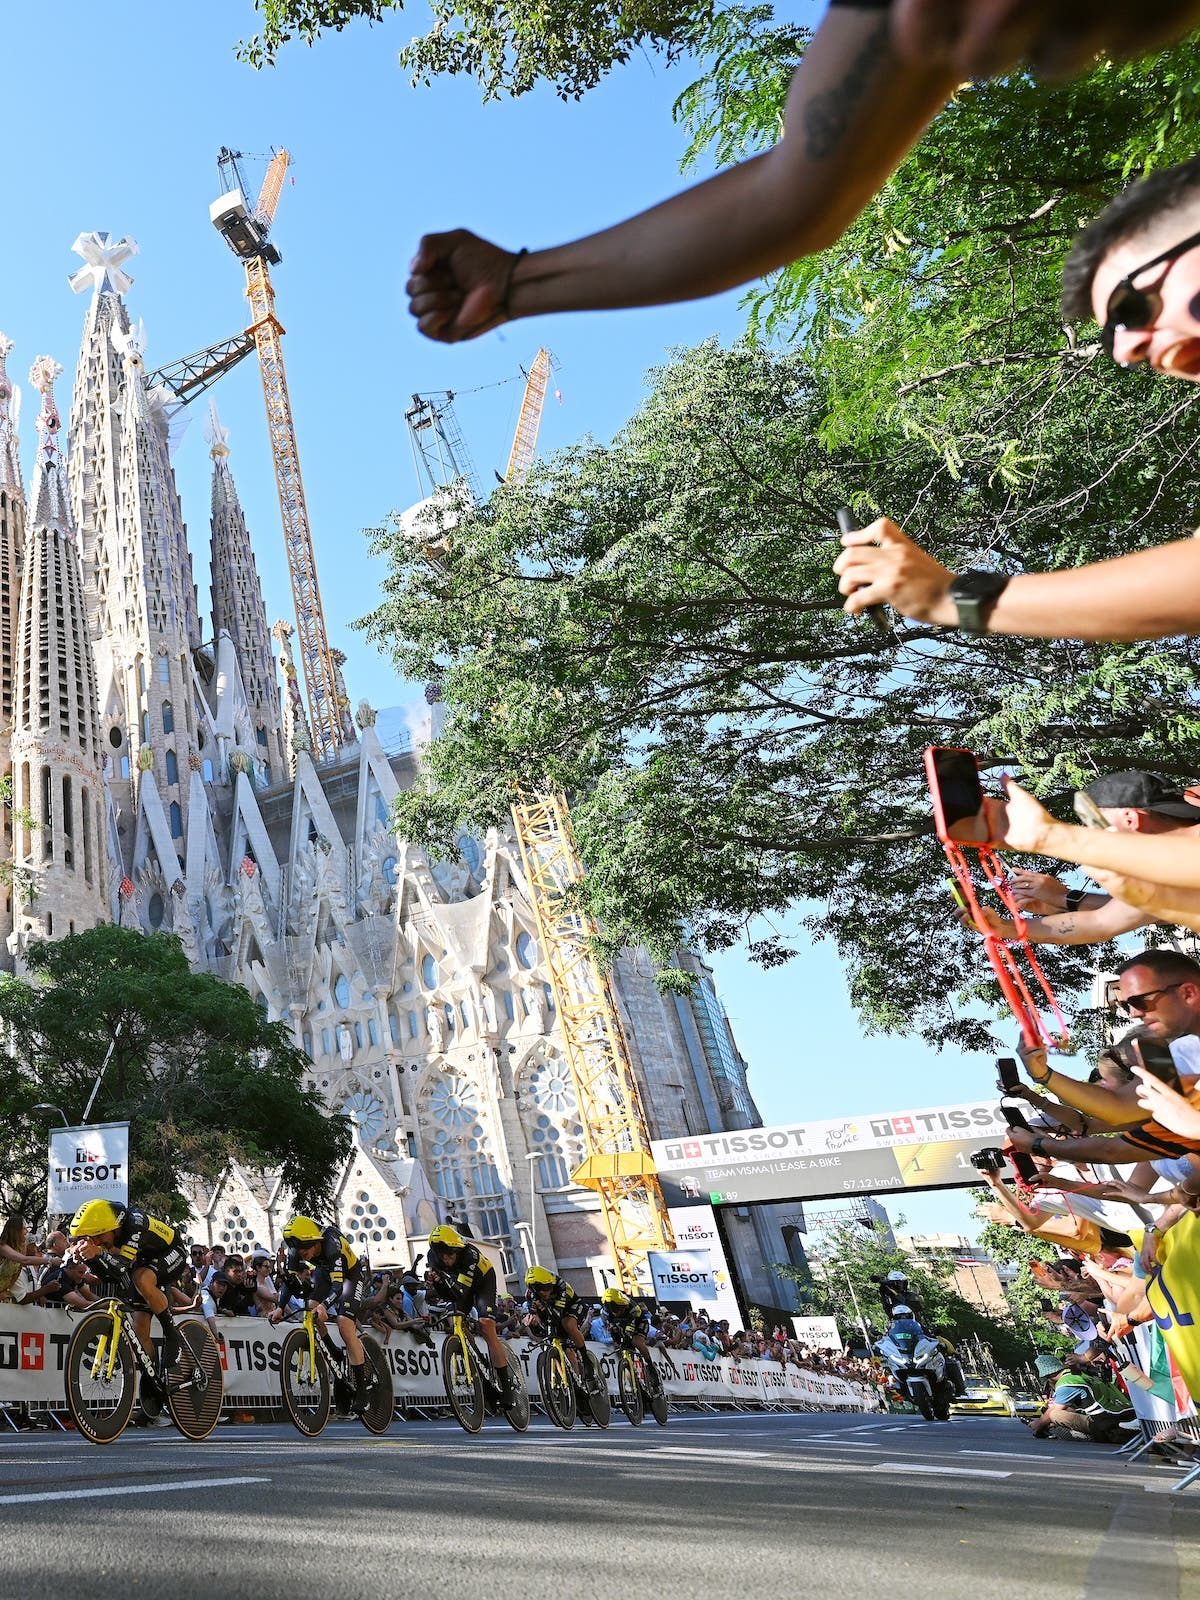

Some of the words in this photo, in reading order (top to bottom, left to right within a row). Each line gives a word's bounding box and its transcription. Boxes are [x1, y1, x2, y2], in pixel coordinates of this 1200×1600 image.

[704, 1129, 806, 1156] TISSOT
[917, 1130, 971, 1143] WATCHES
[55, 1164, 122, 1183] TISSOT
[707, 1168, 735, 1180] TEAM
[737, 1165, 770, 1178] VISMA
[775, 1160, 807, 1173] LEASE
[809, 1159, 818, 1169] A
[819, 1157, 842, 1168] BIKE
[843, 1178, 872, 1190] 57.12
[874, 1176, 902, 1188] km/h
[678, 1231, 714, 1241] TISSOT
[658, 1273, 709, 1284] TISSOT
[1146, 1264, 1194, 1331] CL
[799, 1331, 834, 1339] TISSOT
[694, 1363, 723, 1383] TISSOT
